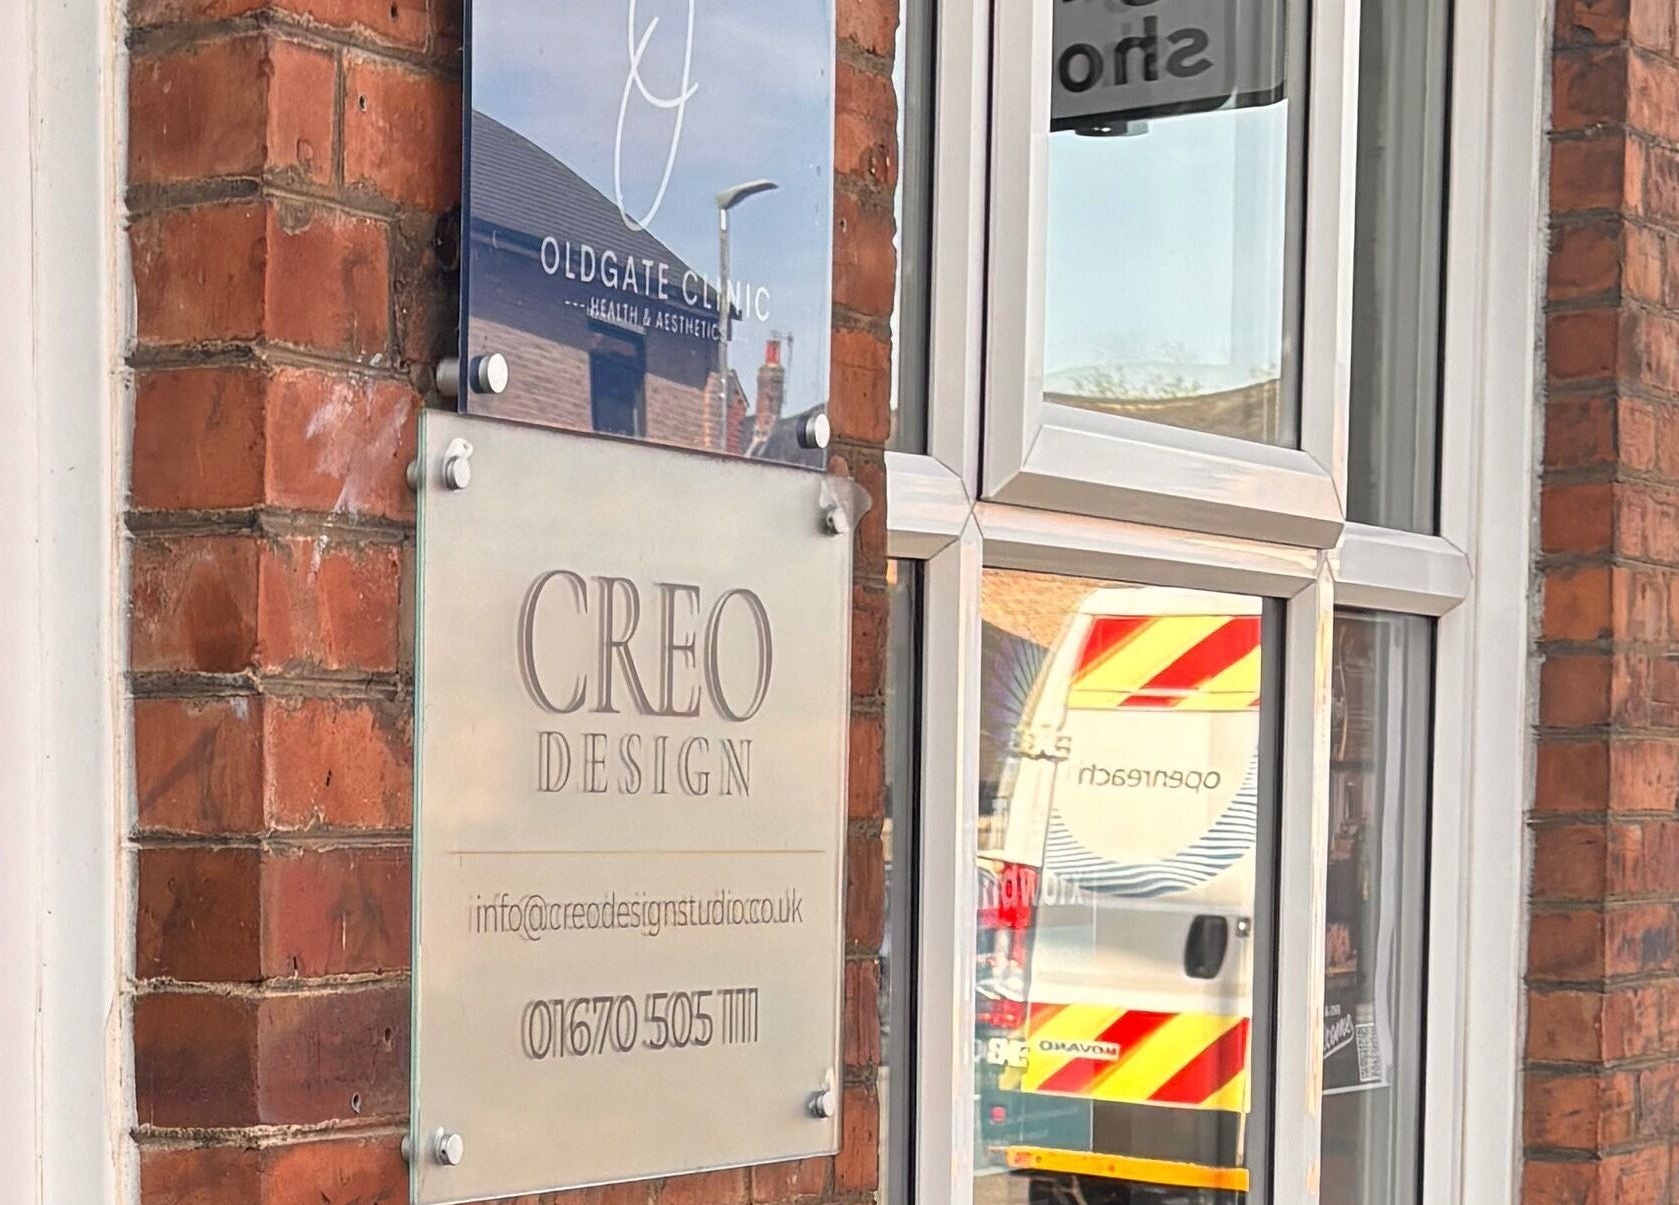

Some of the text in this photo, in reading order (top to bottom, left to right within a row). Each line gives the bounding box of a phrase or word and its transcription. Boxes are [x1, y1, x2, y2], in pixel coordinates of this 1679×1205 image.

[540, 236, 770, 322] OLDGATE CLINIC
[589, 297, 725, 343] HEALTH & AESTHETIC
[518, 570, 773, 722] CREO
[537, 731, 752, 797] DESIGN
[475, 888, 803, 941] info@creodesignstudio.co.uk
[523, 994, 638, 1060] 01670
[643, 990, 713, 1050] 505
